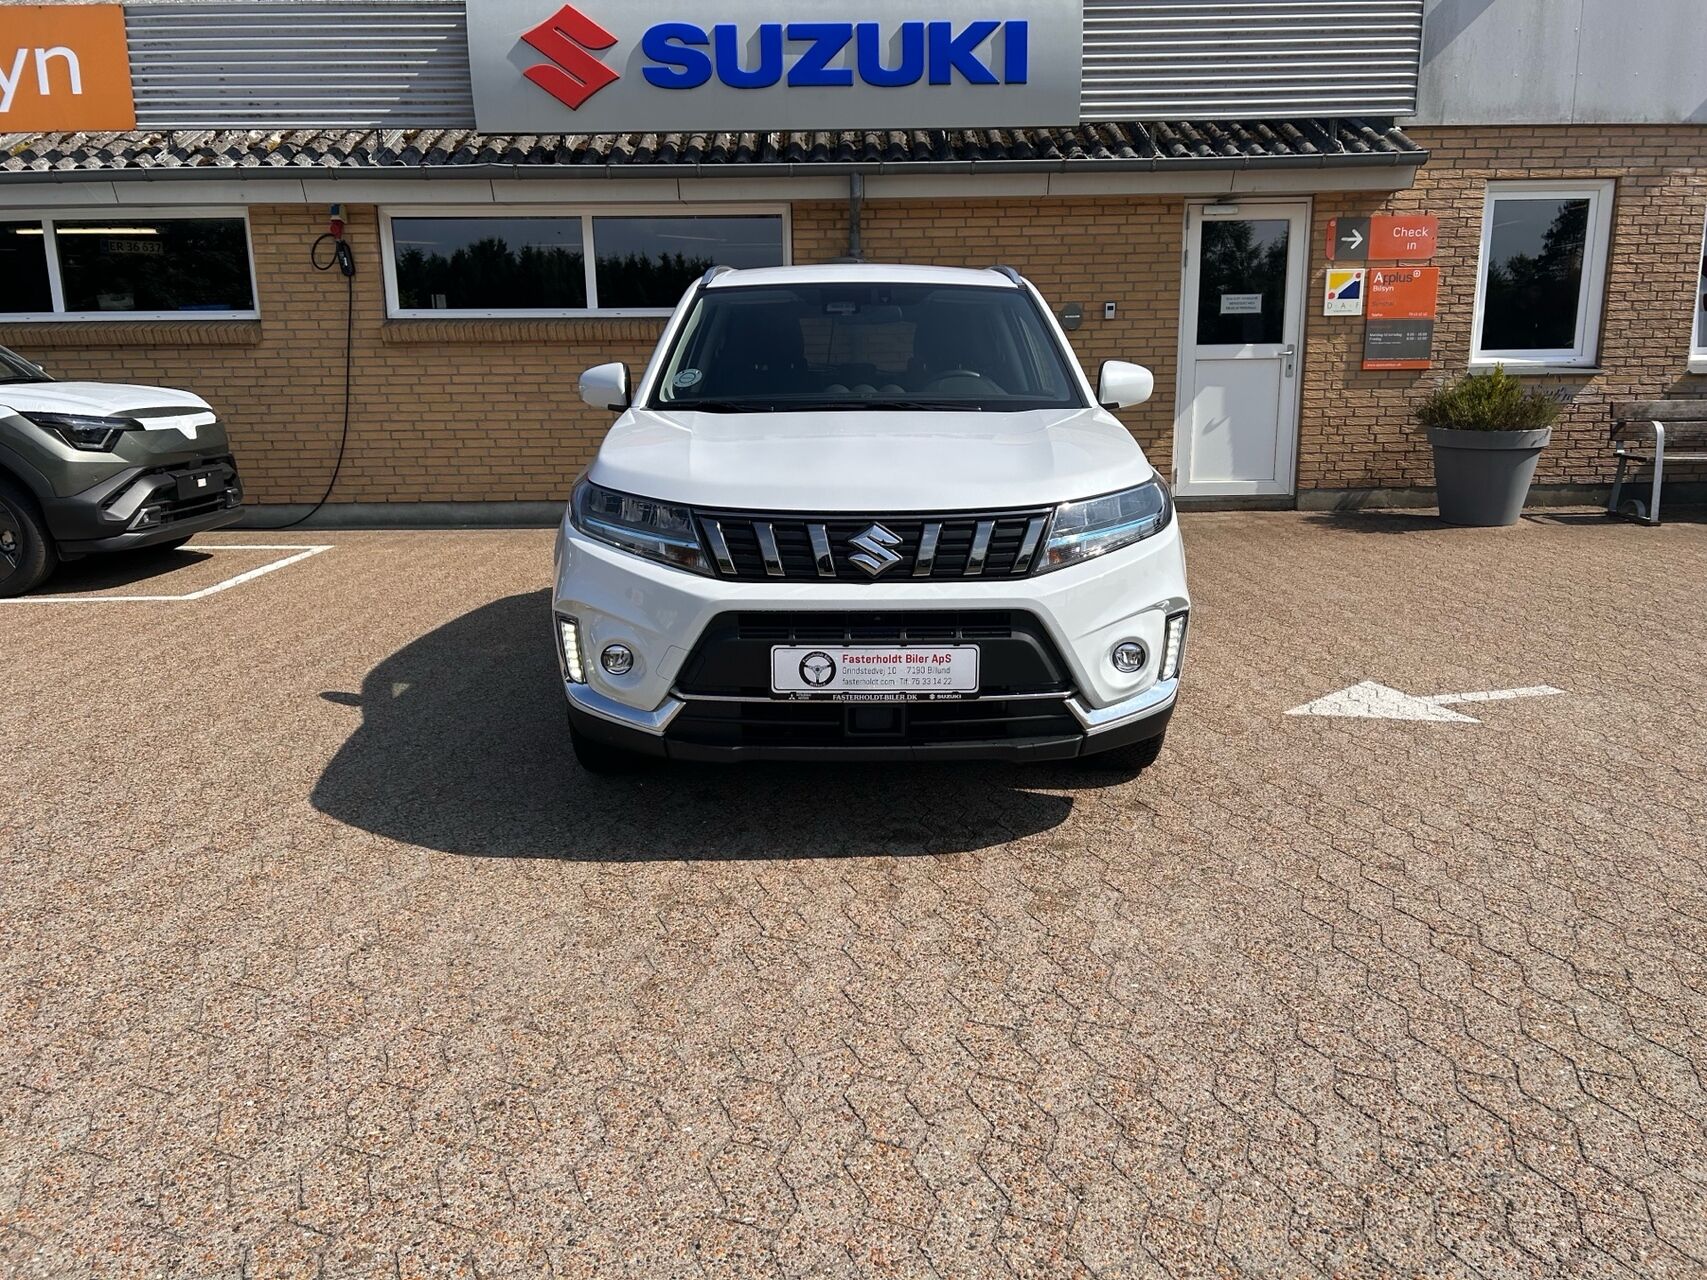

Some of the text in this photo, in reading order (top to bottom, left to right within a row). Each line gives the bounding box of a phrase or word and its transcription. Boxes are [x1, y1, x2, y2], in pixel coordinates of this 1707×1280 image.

[641, 20, 1028, 89] SUZUKI
[1393, 226, 1429, 238] Check
[110, 241, 161, 252] ER 36 637
[1406, 242, 1417, 250] in
[1373, 285, 1395, 293] Bilsyn
[842, 653, 952, 666] Fasterholdt Biler ApS
[842, 666, 952, 676] Grindstedvej 10 7190 Billund
[922, 677, 931, 685] 33
[933, 677, 942, 685] 14
[943, 677, 953, 685] 22
